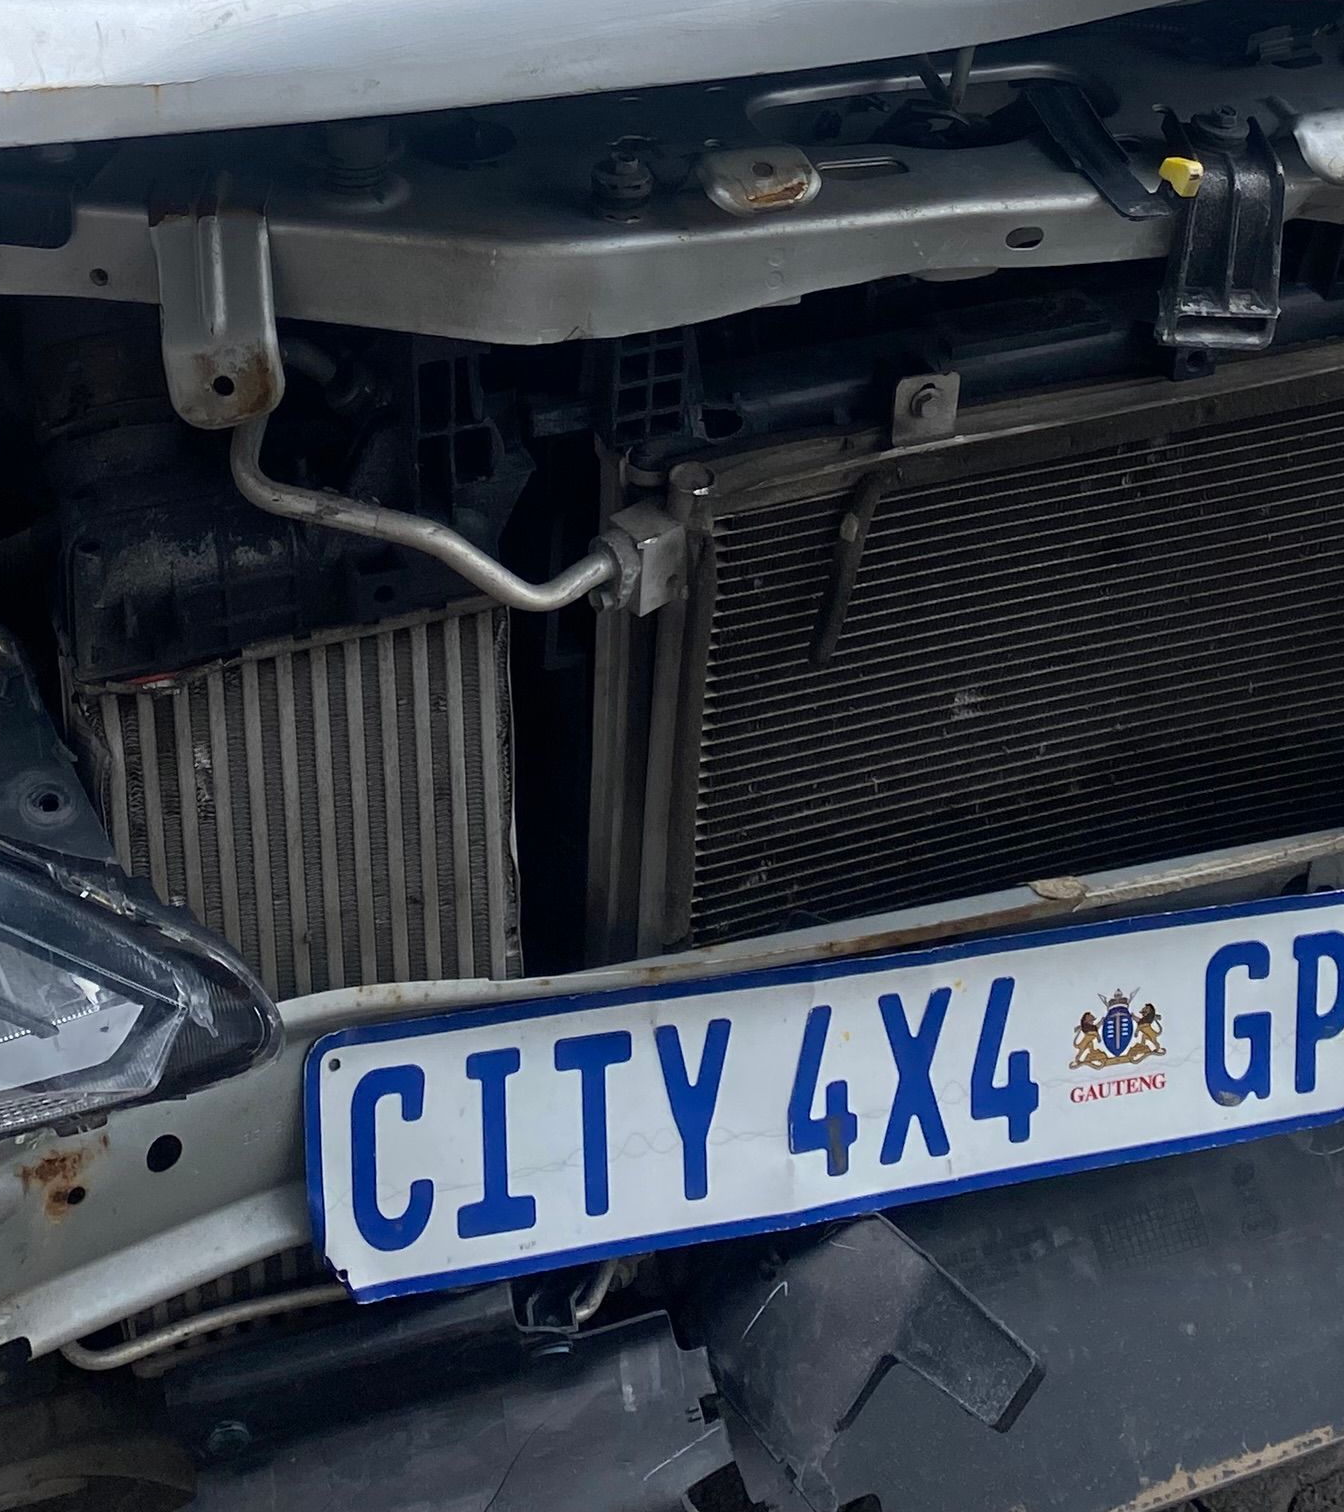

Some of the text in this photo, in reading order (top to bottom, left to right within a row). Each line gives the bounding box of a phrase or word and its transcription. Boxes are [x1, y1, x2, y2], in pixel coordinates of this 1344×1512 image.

[350, 1018, 732, 1252] CITY
[788, 976, 1039, 1176] 4X4
[1069, 1073, 1167, 1105] GAUTENG
